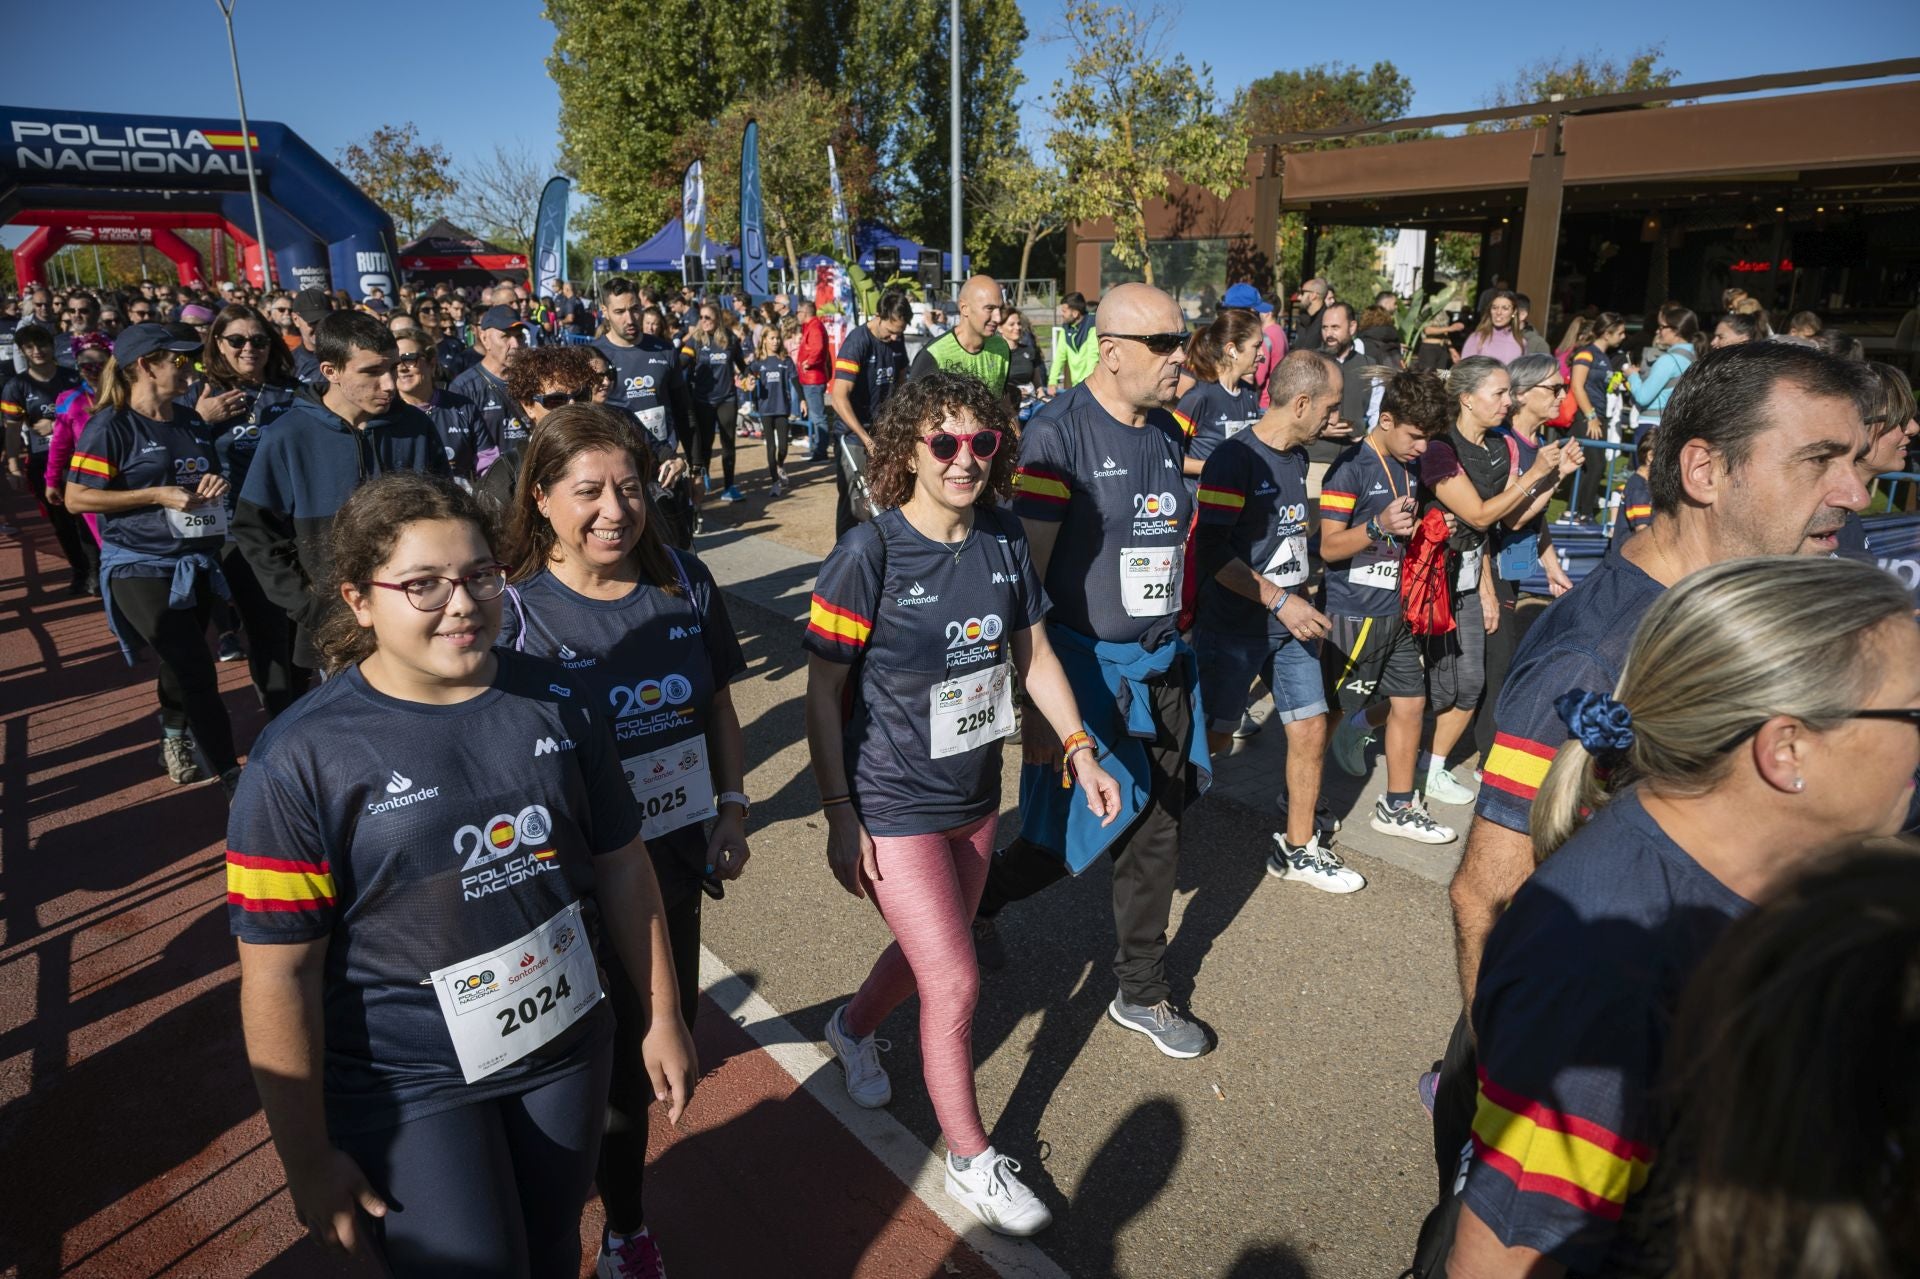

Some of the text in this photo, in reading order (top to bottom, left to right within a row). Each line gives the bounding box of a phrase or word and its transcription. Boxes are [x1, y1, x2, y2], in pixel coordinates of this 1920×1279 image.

[11, 121, 213, 150] POLICIA
[17, 147, 262, 175] NACIONAL
[356, 252, 389, 272] RUTA
[624, 375, 655, 391] 200
[174, 457, 209, 475] 200
[1093, 468, 1128, 478] Santander
[1133, 492, 1177, 518] 200
[1279, 503, 1305, 524] 200
[184, 515, 216, 527] 2660
[1133, 519, 1169, 529] POLICIA
[1133, 526, 1178, 536] NACIONAL
[1367, 563, 1399, 579] 3102
[897, 595, 939, 606] Santander
[945, 614, 1003, 650] 200
[946, 645, 990, 661] POLICIA
[946, 652, 997, 668] NACIONAL
[609, 673, 692, 718] 200
[940, 688, 963, 702] 200
[615, 711, 680, 732] POLICIA
[616, 717, 694, 741] NACIONAL
[957, 705, 995, 735] 2298
[642, 769, 675, 785] Santander
[368, 786, 439, 815] Santander
[640, 786, 687, 820] 2025
[453, 804, 552, 873] 200
[461, 853, 539, 890] POLICIA
[463, 860, 560, 901] NACIONAL
[508, 956, 549, 985] Santander
[454, 969, 496, 995] 200
[458, 986, 491, 1001] POLICIA
[459, 988, 500, 1005] NACIONAL
[496, 973, 571, 1037] 2024
